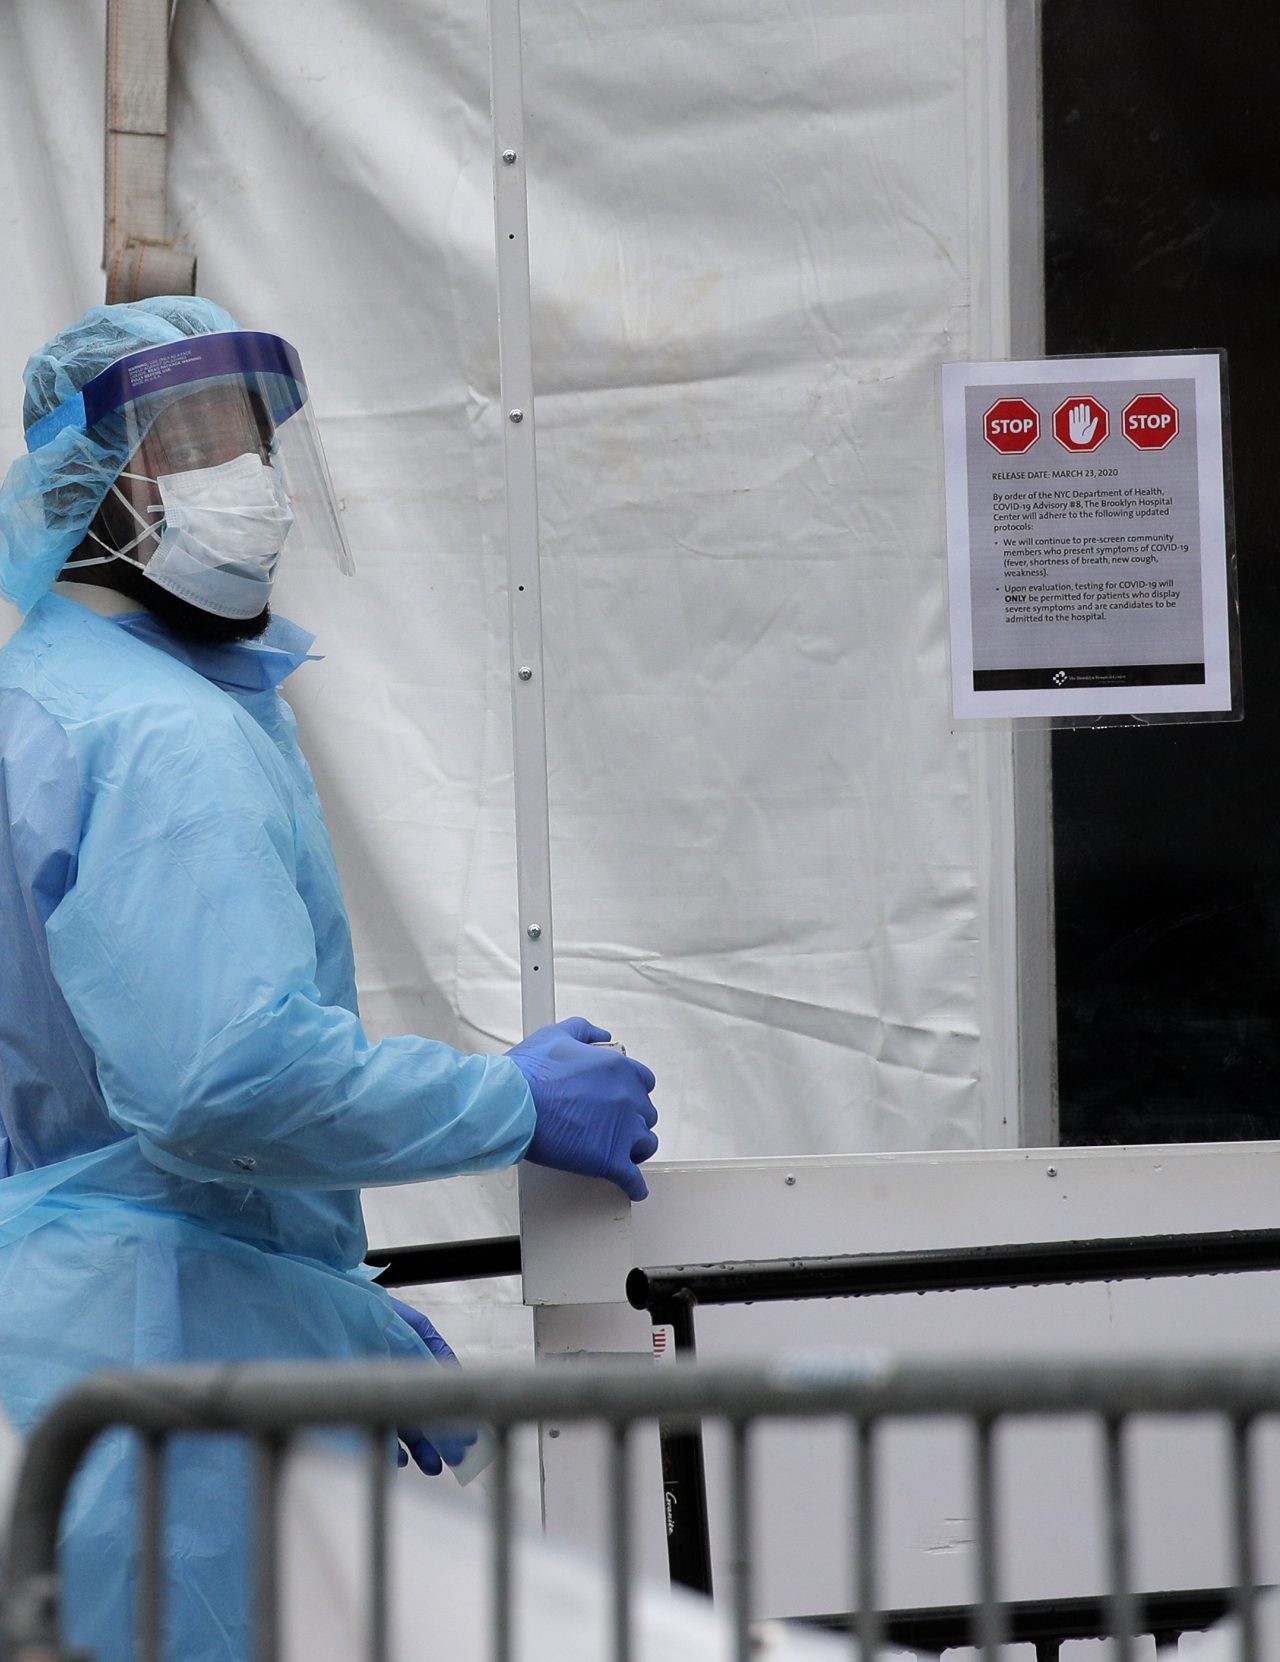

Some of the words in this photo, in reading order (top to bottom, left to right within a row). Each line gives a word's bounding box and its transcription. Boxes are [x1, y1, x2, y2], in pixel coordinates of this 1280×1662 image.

[991, 419, 1033, 435] STOP
[1128, 414, 1171, 430] STOP
[992, 472, 1026, 480] RELEASE
[1027, 471, 1050, 479] DATE:
[1052, 470, 1083, 478] MARCH
[1085, 469, 1096, 478] 23,
[1098, 468, 1119, 477] 2020
[992, 493, 1003, 502] By
[1004, 492, 1026, 500] order
[1028, 491, 1037, 499] of
[1039, 491, 1052, 499] the
[1054, 490, 1071, 499] NYC
[1072, 489, 1122, 499] Department
[1124, 488, 1133, 496] of
[1135, 487, 1164, 496] Health,
[993, 503, 1031, 511] COVID-19
[1033, 501, 1068, 510] Advisory
[1070, 500, 1083, 509] #8,
[1084, 500, 1099, 508] The
[1101, 499, 1137, 508] Brooklyn
[1138, 497, 1173, 507] Hospital
[993, 513, 1020, 521] Center
[1022, 512, 1037, 520] will
[1039, 511, 1066, 520] adhere
[1095, 509, 1134, 519] following
[1135, 508, 1169, 518] updated
[993, 523, 1034, 533] protocols:
[1003, 538, 1016, 546] We
[1018, 538, 1033, 546] will
[1035, 537, 1071, 545] continue
[1083, 536, 1125, 546] pre-screen
[1127, 533, 1174, 543] community
[1003, 548, 1042, 556] members
[1043, 547, 1062, 555] who
[1063, 547, 1094, 556] present
[1096, 546, 1139, 555] symptoms
[1140, 544, 1150, 552] of
[1150, 544, 1189, 552] COVID-19
[1003, 559, 1029, 568] (fever,
[1030, 558, 1069, 566] shortness
[1071, 557, 1080, 565] of
[1081, 556, 1111, 564] breath,
[1130, 554, 1159, 564] cough,
[1003, 568, 1049, 577] weakness).
[1004, 585, 1026, 593] Upon
[1028, 583, 1074, 592] evaluation,
[1074, 582, 1104, 591] testing
[1105, 581, 1117, 589] for
[1119, 581, 1157, 589] COVID-19
[1158, 579, 1174, 587] will
[1004, 595, 1027, 603] ONLY
[1028, 594, 1039, 602] be
[1040, 593, 1081, 603] permitted
[1083, 592, 1094, 600] for
[1096, 592, 1130, 601] patients
[1151, 590, 1180, 599] display
[1032, 604, 1075, 614] symptoms
[1077, 602, 1093, 611] and
[1109, 601, 1154, 609] candidates
[1166, 600, 1176, 608] be
[1005, 614, 1043, 623] admitted
[1044, 614, 1054, 622] to
[1056, 613, 1069, 621] the
[1071, 612, 1107, 622] hospital.
